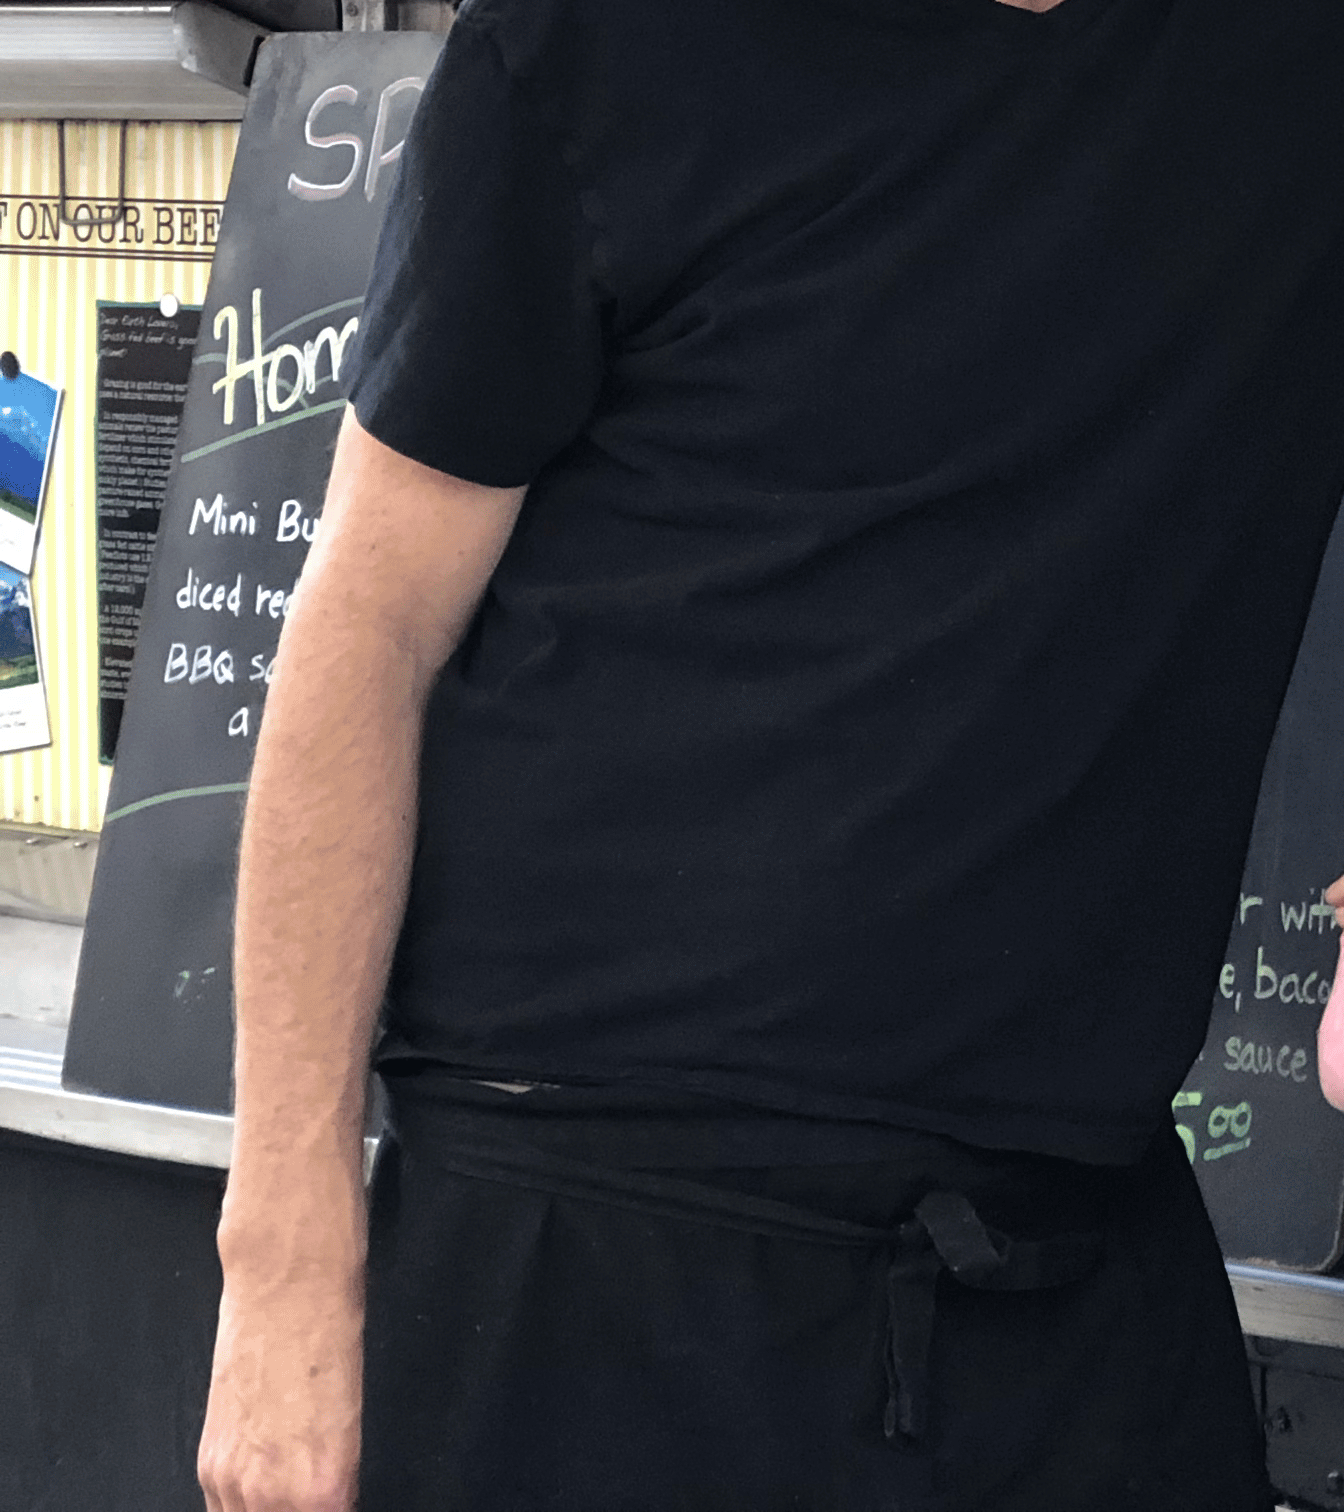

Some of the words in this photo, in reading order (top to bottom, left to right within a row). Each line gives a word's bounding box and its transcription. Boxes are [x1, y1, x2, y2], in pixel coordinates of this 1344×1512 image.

[16, 201, 61, 241] ON
[72, 204, 144, 244] OUR
[152, 206, 221, 246] BEE
[189, 494, 258, 535] Mini
[176, 568, 241, 617] diced
[164, 643, 234, 684] BBQ
[1254, 946, 1330, 1005] baco
[1223, 1036, 1308, 1083] sauce
